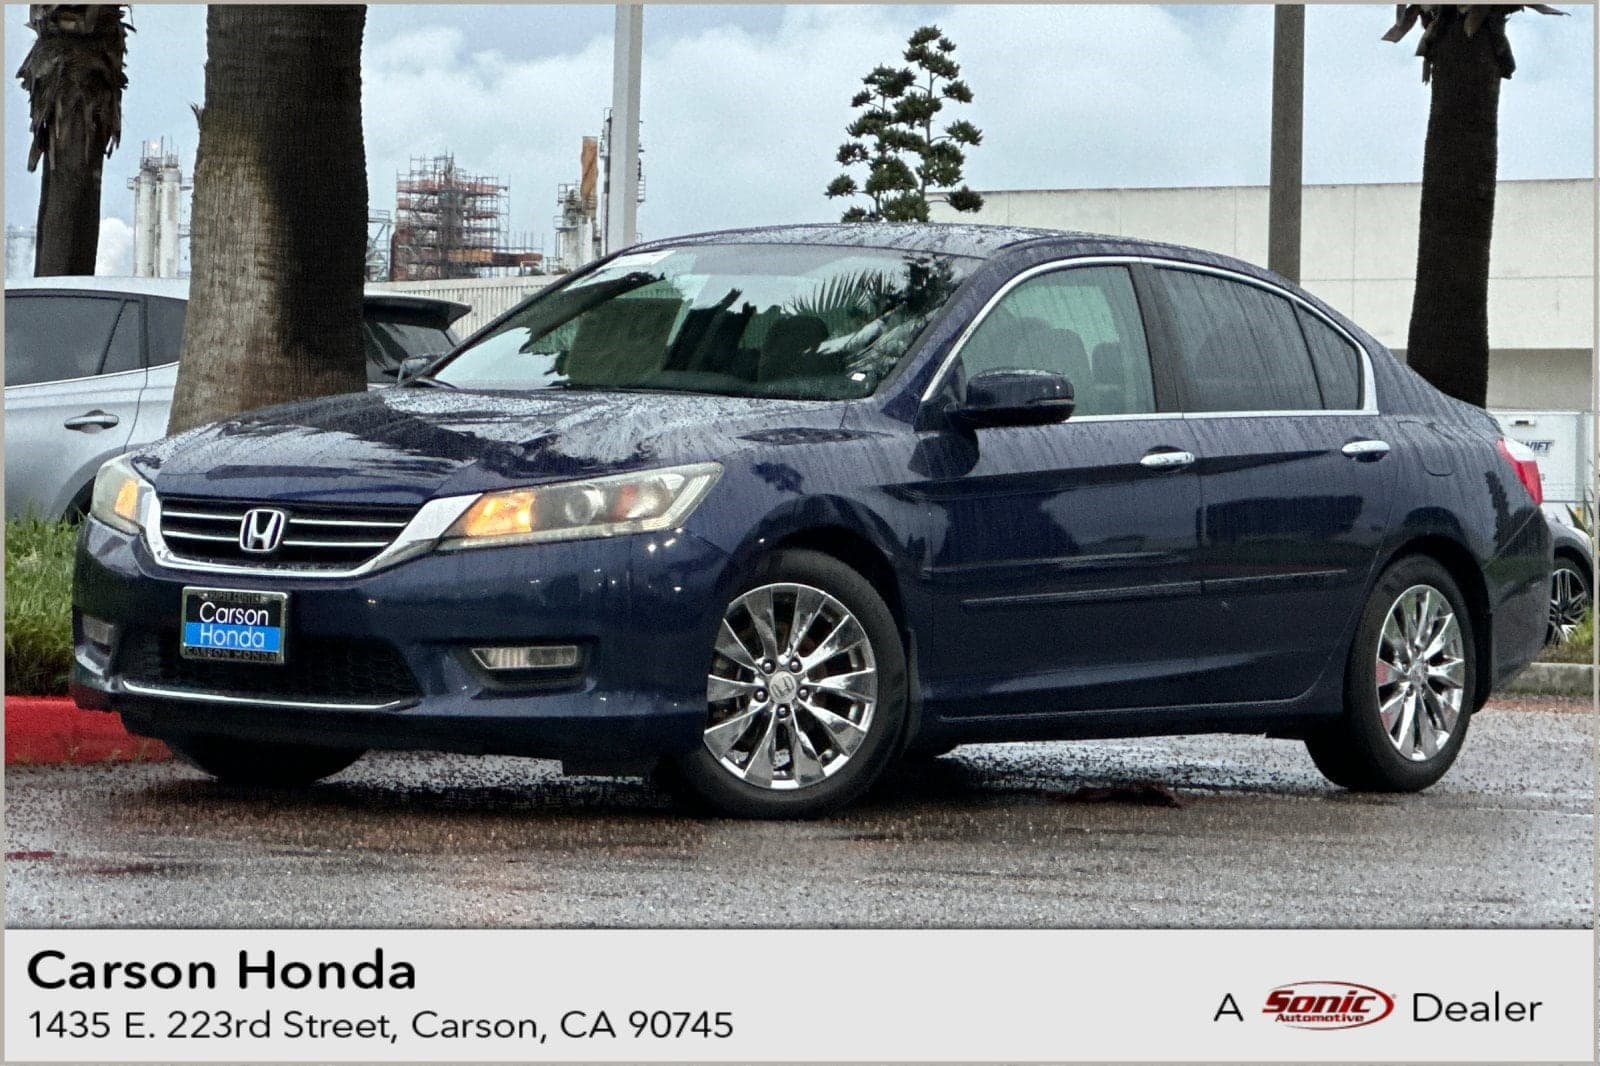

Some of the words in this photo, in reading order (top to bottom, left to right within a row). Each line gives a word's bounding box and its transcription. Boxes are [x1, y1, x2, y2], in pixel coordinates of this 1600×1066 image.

[1519, 441, 1553, 451] WIFT
[199, 601, 269, 626] Carson
[199, 623, 265, 648] Honda
